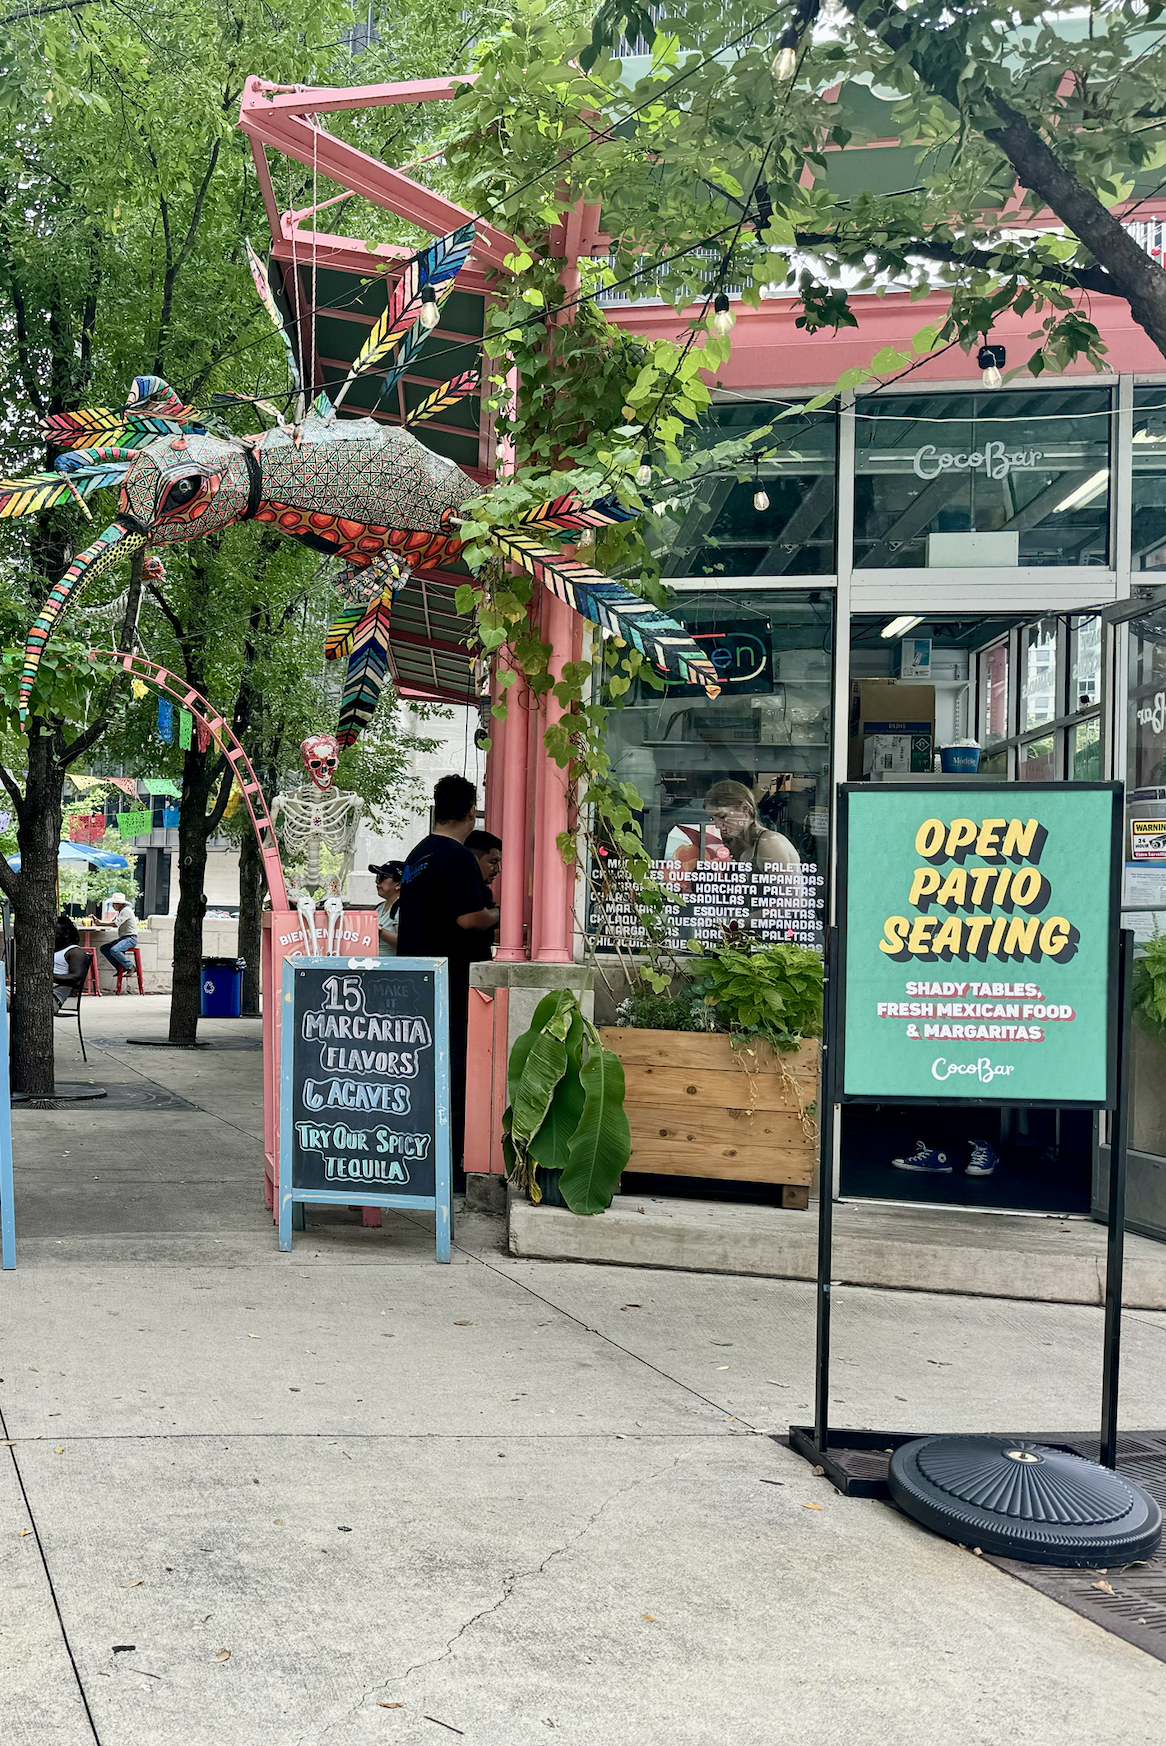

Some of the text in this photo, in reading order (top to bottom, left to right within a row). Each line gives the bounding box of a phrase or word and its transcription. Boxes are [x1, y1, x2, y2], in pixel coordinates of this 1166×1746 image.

[913, 440, 1043, 480] CocoBar
[915, 818, 1044, 862] OPEN
[696, 861, 752, 872] ESQUITES
[764, 862, 817, 873] PALETAS
[669, 872, 746, 883] QUESADILLAS
[752, 874, 824, 886] EMPANADAS
[908, 867, 1047, 910] PATIO
[696, 883, 757, 895] HORCHATA
[763, 886, 816, 897] PALETAS
[694, 906, 749, 918] ESQUITES
[762, 909, 815, 919] PALETAS
[751, 897, 824, 909] EMPANADAS
[750, 919, 823, 930] EMPANADAS
[362, 936, 371, 946] A
[762, 931, 815, 942] PALETAS
[879, 916, 1076, 960] SEATING
[326, 978, 362, 1012] 15
[906, 982, 1044, 999] SHADY TABLES,
[877, 1003, 1074, 1019] FRESH MEXICAN FOOD
[306, 1015, 427, 1044] MARGARITA
[906, 1024, 1043, 1040] & MARGARITAS
[326, 1047, 414, 1074] FLAVORS
[931, 1057, 1014, 1083] CocoBar
[326, 1081, 406, 1112] AGAVES
[297, 1124, 428, 1157] TRY OUR SPICY
[325, 1157, 405, 1180] TEQUILA
